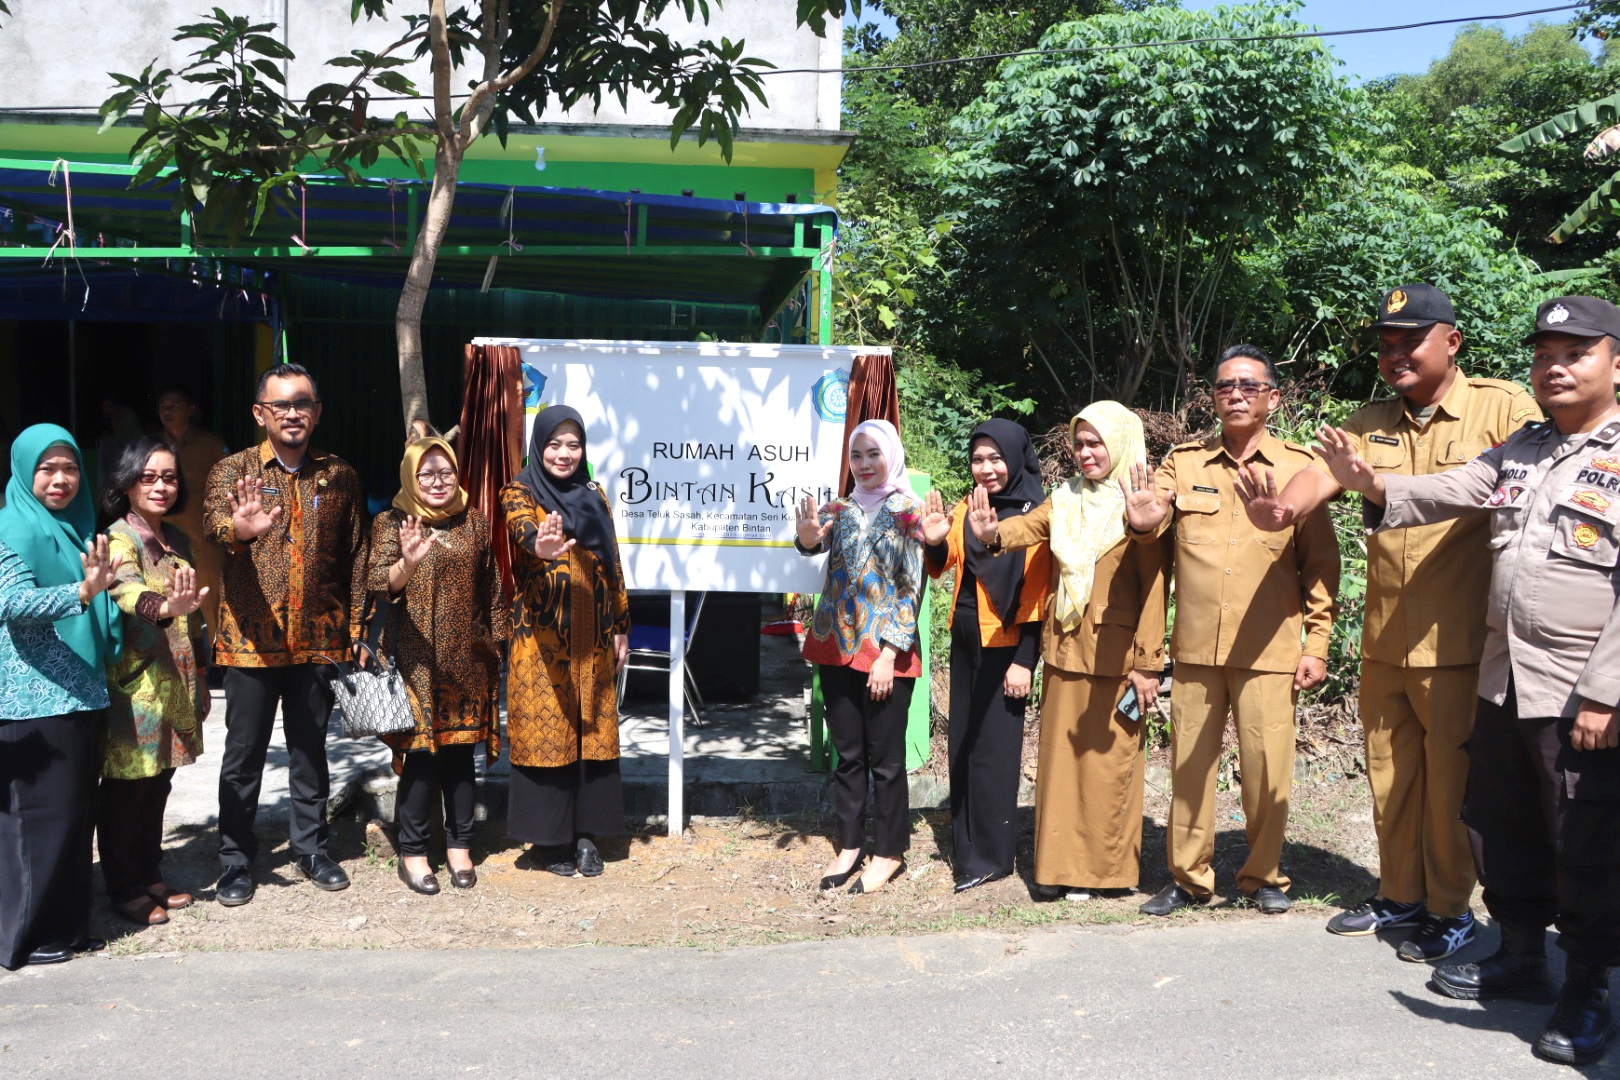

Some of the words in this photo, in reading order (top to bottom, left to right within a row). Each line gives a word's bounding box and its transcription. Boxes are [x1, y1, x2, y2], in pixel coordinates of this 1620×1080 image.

[653, 442, 734, 460] RUMAH
[747, 444, 809, 462] ASUH
[620, 467, 735, 505] BINTAN
[1576, 469, 1620, 494] POLR
[621, 509, 645, 518] Desa
[647, 509, 671, 519] Teluk
[706, 511, 758, 521] Kecamatan
[760, 512, 779, 521] Seri
[691, 522, 740, 533] Kabupaten
[742, 523, 771, 533] Bintan
